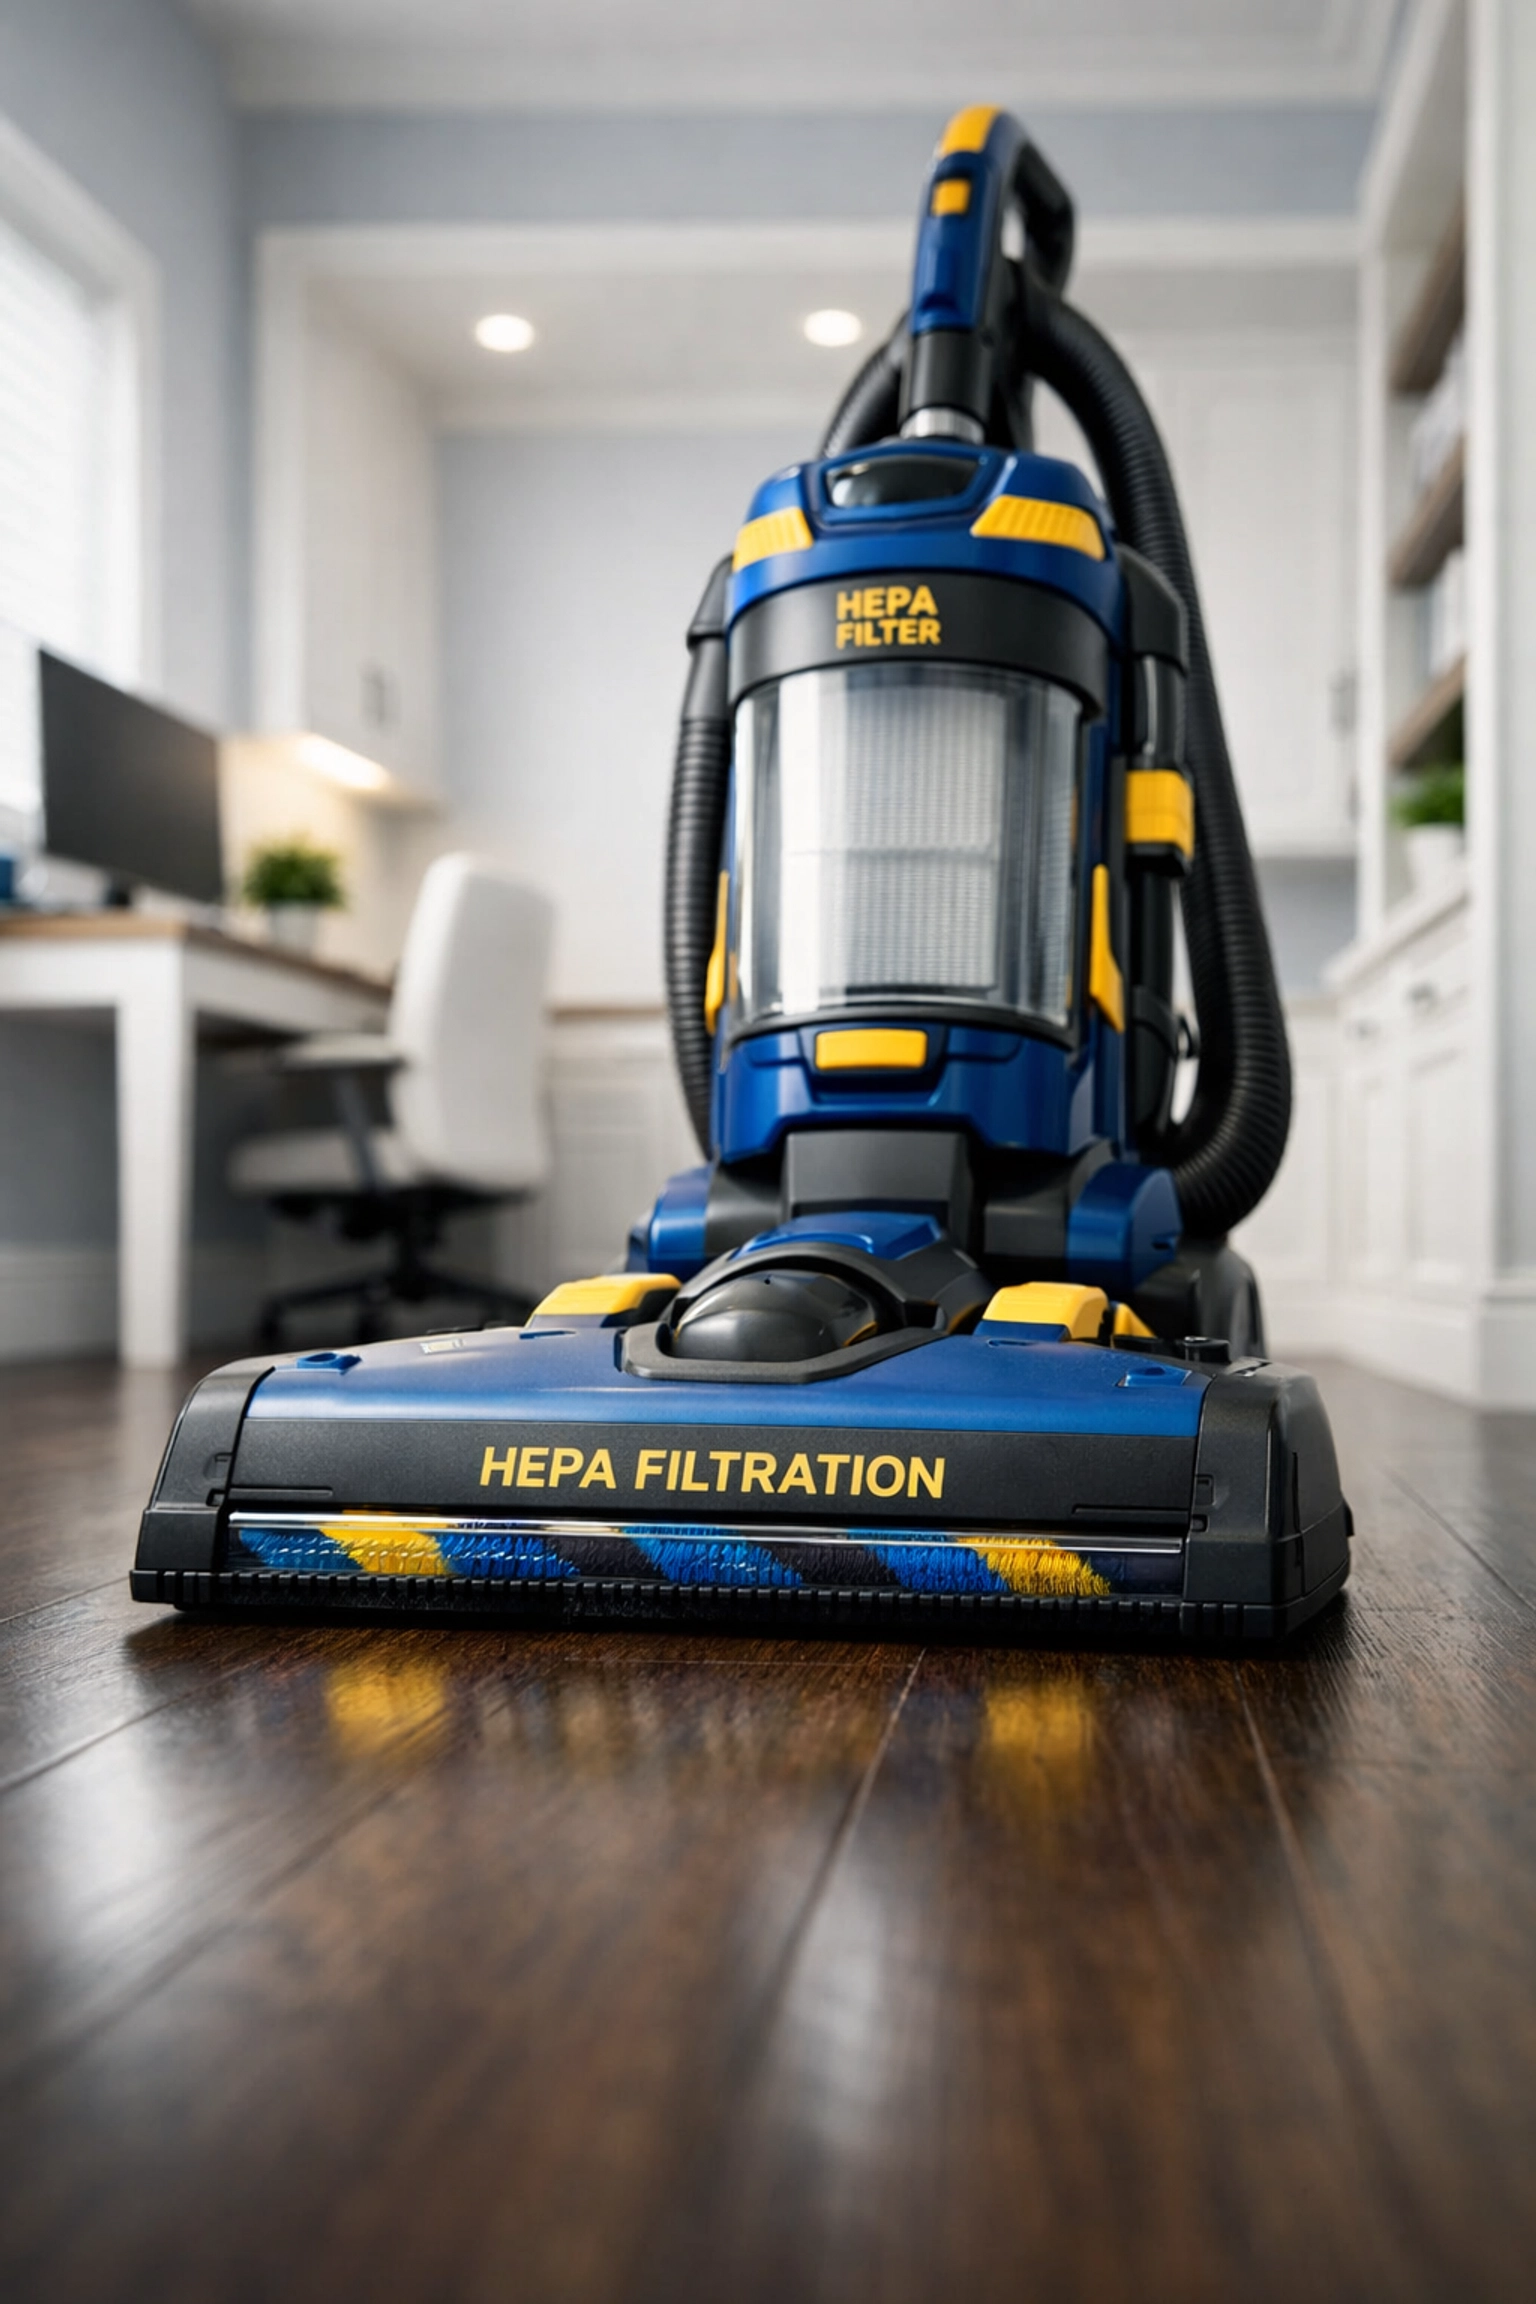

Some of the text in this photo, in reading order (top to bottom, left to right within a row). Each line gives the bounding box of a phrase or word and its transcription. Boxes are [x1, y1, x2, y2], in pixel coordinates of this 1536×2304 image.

[836, 585, 938, 620] HEPA
[836, 618, 941, 650] FILTER
[480, 1446, 946, 1499] HEPA FILTRATION
